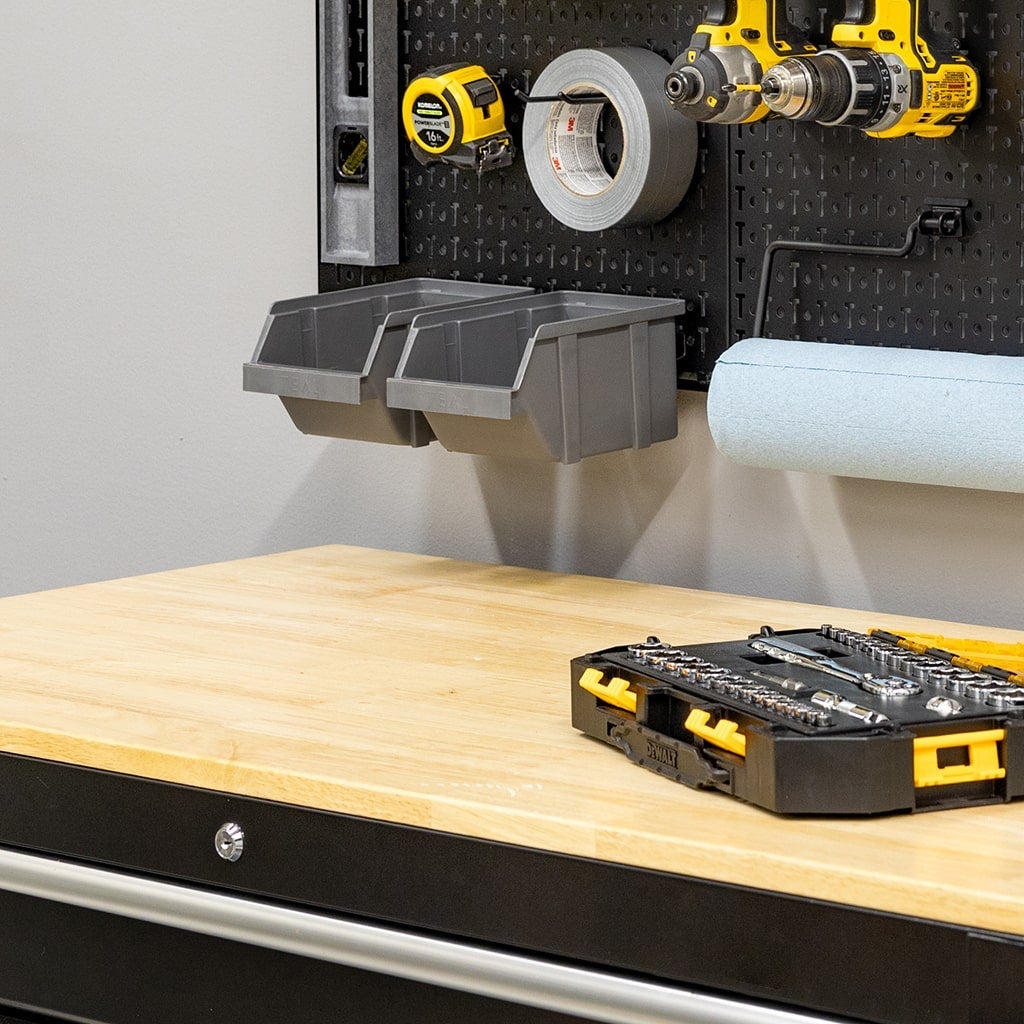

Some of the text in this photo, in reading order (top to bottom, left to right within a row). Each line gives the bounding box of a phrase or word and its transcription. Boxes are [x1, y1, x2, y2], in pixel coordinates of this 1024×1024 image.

[881, 69, 890, 81] 13
[882, 94, 890, 105] 11
[567, 116, 576, 132] 3M
[426, 131, 437, 142] 16
[552, 156, 562, 171] 3M
